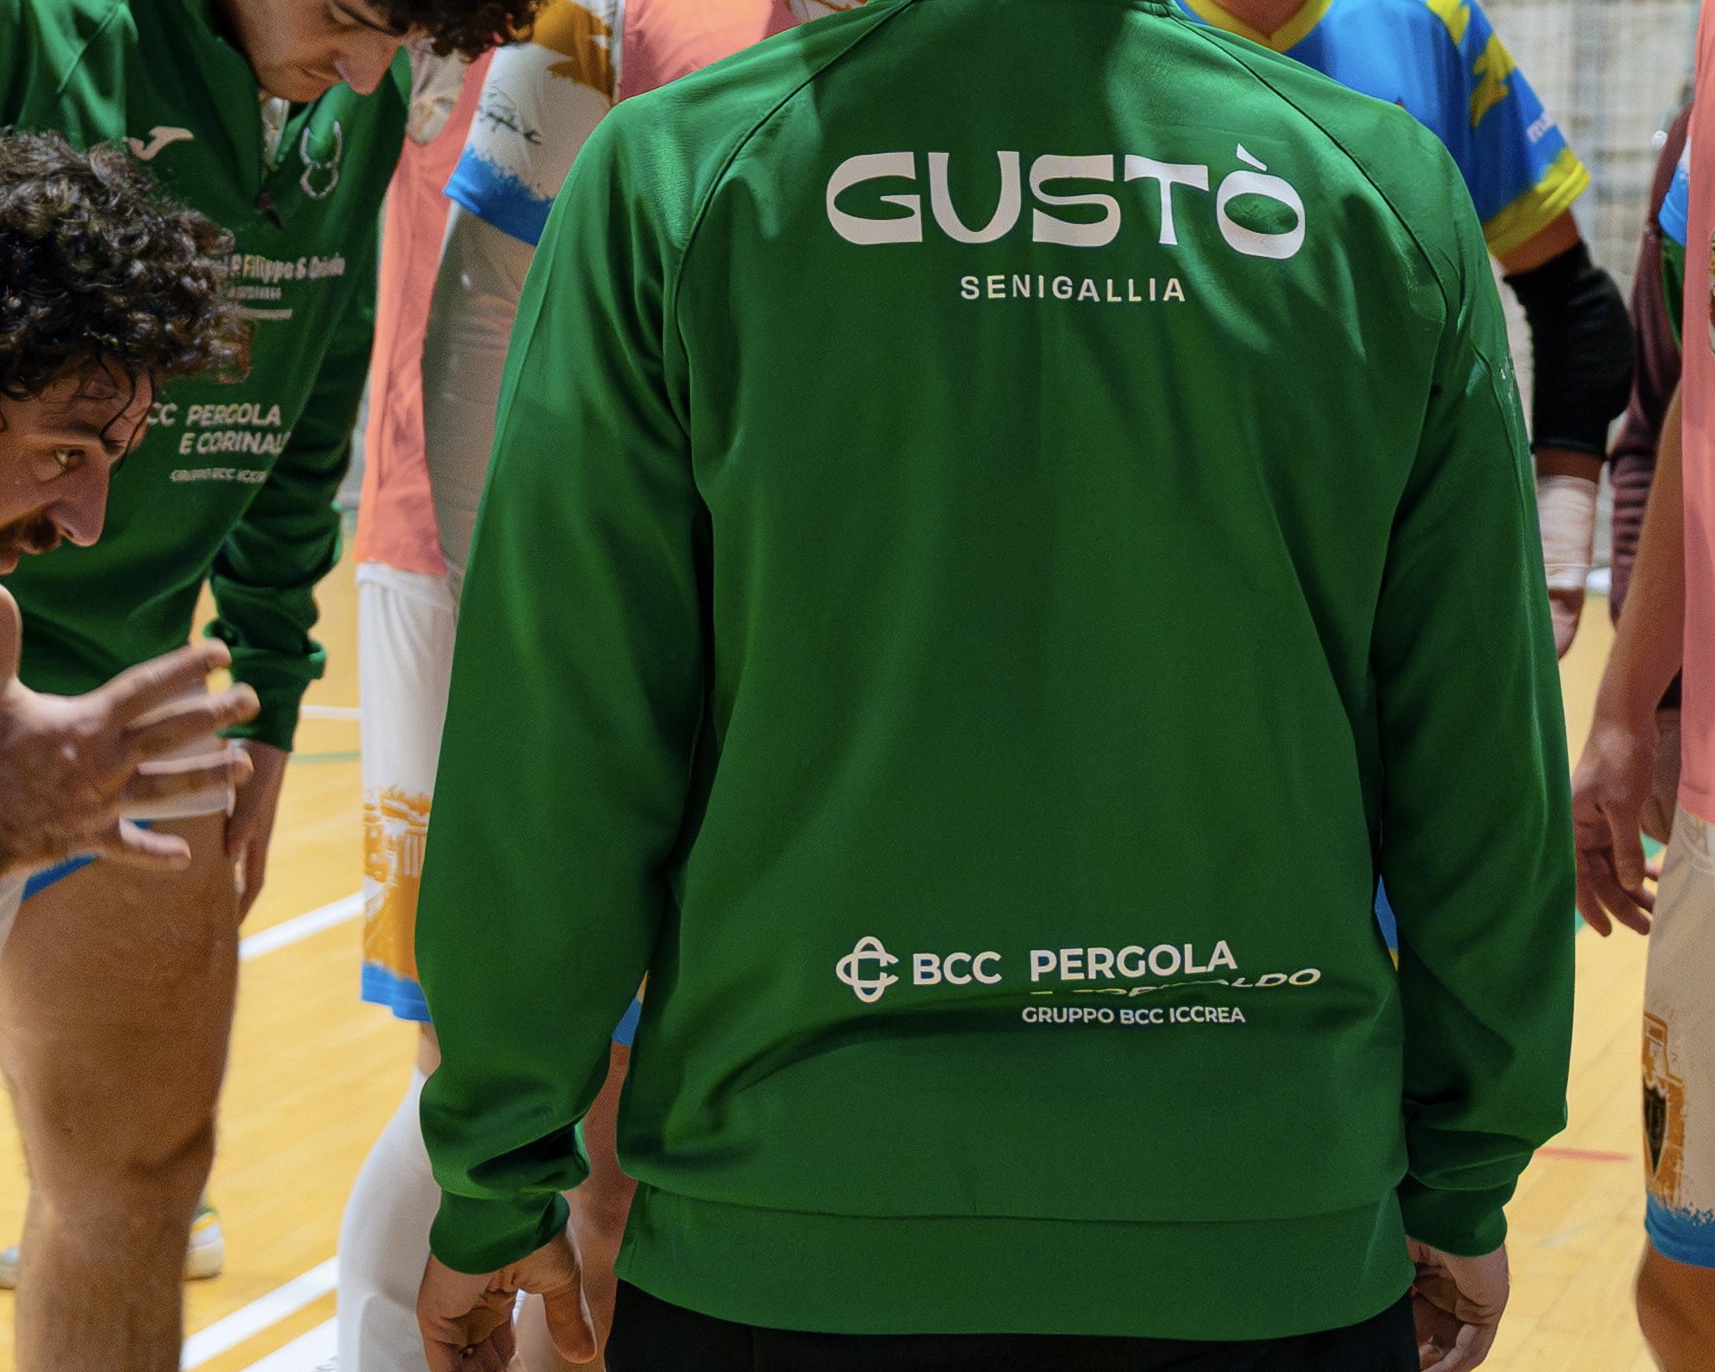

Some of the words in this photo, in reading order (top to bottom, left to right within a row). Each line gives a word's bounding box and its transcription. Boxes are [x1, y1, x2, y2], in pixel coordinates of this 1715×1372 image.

[826, 143, 1305, 259] GUSTÒ
[960, 274, 1185, 303] SENIGALLIA
[146, 401, 178, 427] CC
[185, 401, 282, 427] PERGOLA
[178, 432, 195, 455] E
[912, 951, 1002, 986] BCC
[1029, 940, 1238, 982] PERGOLA
[1021, 1006, 1115, 1024] GRUPPO
[1119, 1008, 1164, 1025] BCC
[1168, 1005, 1246, 1024] ICCREA
